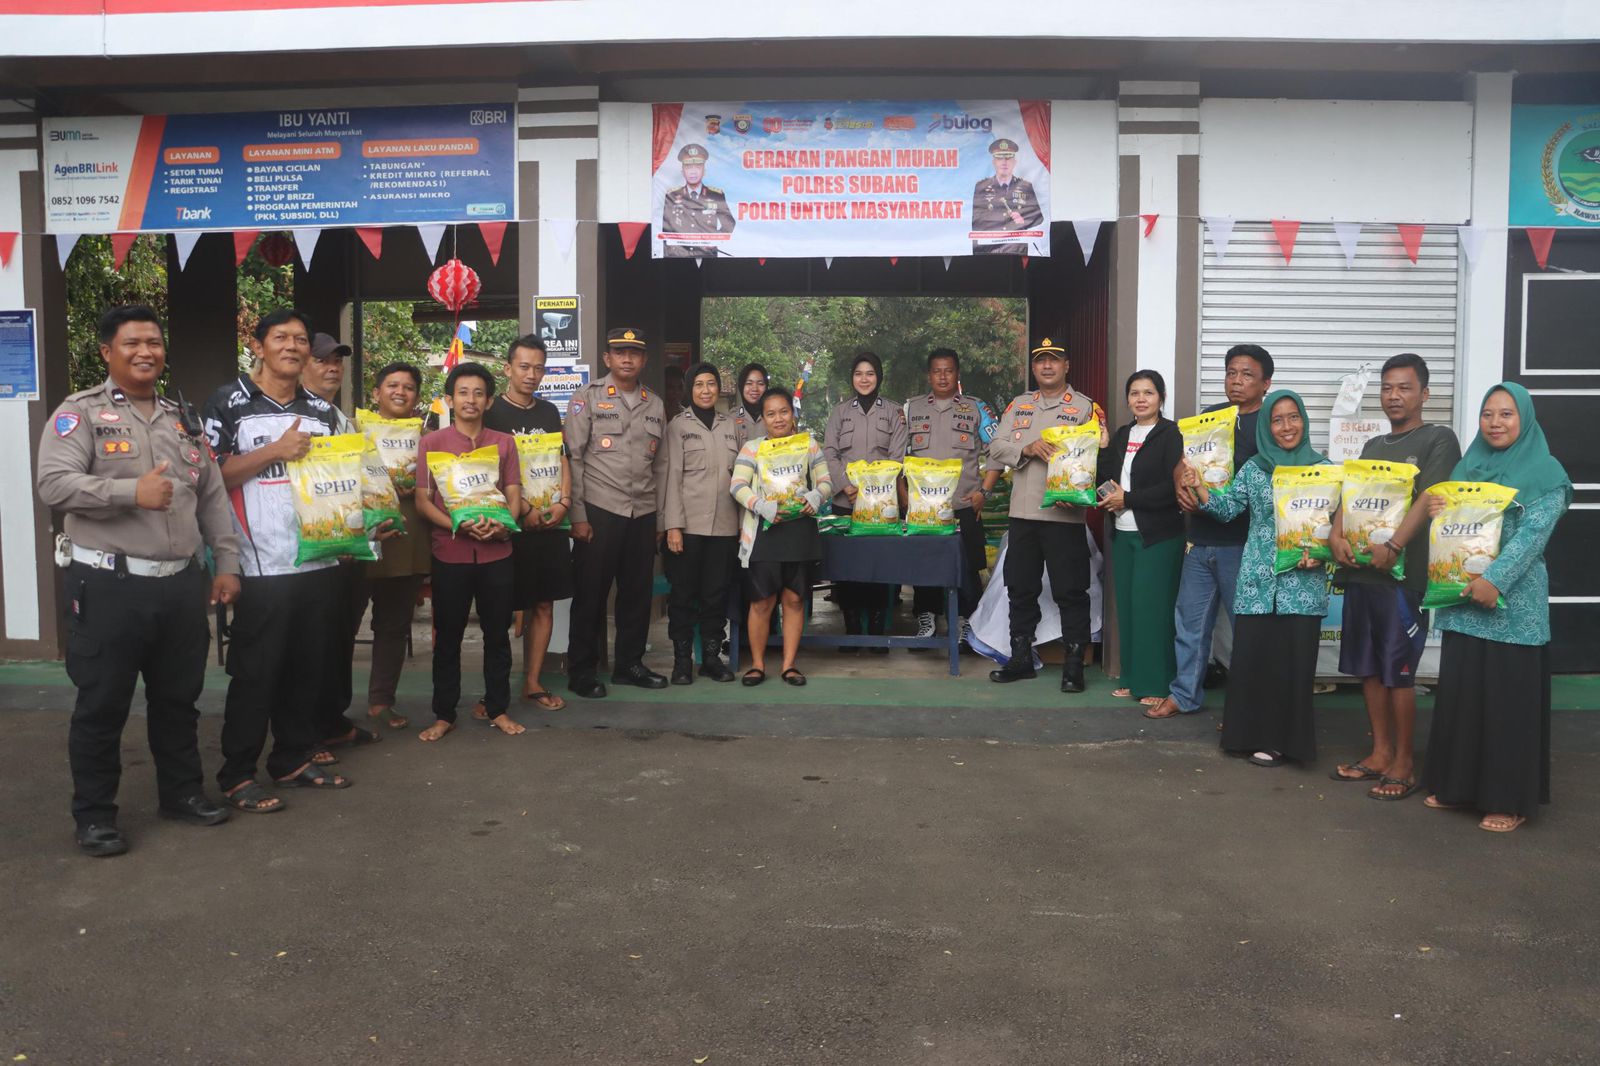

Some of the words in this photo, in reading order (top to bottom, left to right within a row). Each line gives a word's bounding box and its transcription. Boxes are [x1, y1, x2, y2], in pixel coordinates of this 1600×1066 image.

[279, 113, 303, 127] IBU
[308, 112, 350, 126] YANTI
[485, 110, 507, 124] BRI
[942, 113, 993, 133] bulog
[267, 131, 297, 140] Melayani
[298, 130, 323, 138] Seluruh
[324, 129, 362, 138] Masyarakat
[248, 149, 291, 157] LAYANAN
[293, 147, 313, 155] MINI
[315, 147, 334, 155] ATM
[368, 145, 411, 154] LAYANAN
[413, 144, 437, 152] LAKU
[439, 143, 474, 151] PANDAI
[170, 151, 212, 160] LAYANAN
[742, 149, 819, 170] GERAKAN
[824, 149, 892, 169] PANGAN
[896, 148, 959, 168] MURAH
[54, 162, 119, 176] AgenBRILink
[198, 168, 224, 176] TUNAI
[285, 164, 321, 172] CICILAN
[254, 175, 273, 183] BELI
[275, 174, 303, 182] PULSA
[369, 172, 403, 180] KREDIT
[405, 171, 436, 179] MIKRO
[440, 169, 491, 178] (REFERRAL
[170, 178, 194, 186] TARIK
[196, 177, 222, 185] TUNAI
[782, 175, 845, 194] POLRES
[848, 175, 918, 194] SUBANG
[170, 186, 218, 195] REGISTRASI
[254, 184, 299, 192] TRANSFER
[51, 197, 72, 206] 0852
[76, 196, 96, 205] 1096
[99, 195, 119, 205] 7542
[287, 192, 315, 200] BRIZZI
[369, 193, 417, 201] ASURANSI
[419, 191, 451, 199] MIKRO
[254, 203, 299, 211] PROGRAM
[301, 201, 358, 210] PEMERINTAH
[738, 202, 786, 221] POLRI
[790, 202, 847, 220] UNTUK
[851, 201, 964, 220] MASYARAKAT
[319, 210, 339, 219] DLL)
[539, 300, 575, 308] PERHATIAN
[544, 339, 562, 348] REA
[565, 339, 578, 348] INI
[553, 383, 582, 391] MALAM
[952, 414, 974, 422] POLRI
[1056, 414, 1078, 423] POLRI
[1341, 422, 1350, 432] ES
[1351, 422, 1381, 433] KELAPA
[382, 438, 417, 449] SPHP
[530, 465, 559, 478] SPHP
[772, 463, 803, 477] SPHP
[314, 479, 357, 495] SPHP
[865, 484, 893, 495] SPHP
[920, 486, 950, 495] SPHP
[1290, 498, 1330, 510] SPHP
[1352, 497, 1389, 511] SPHP
[1441, 521, 1483, 536] SPHP
